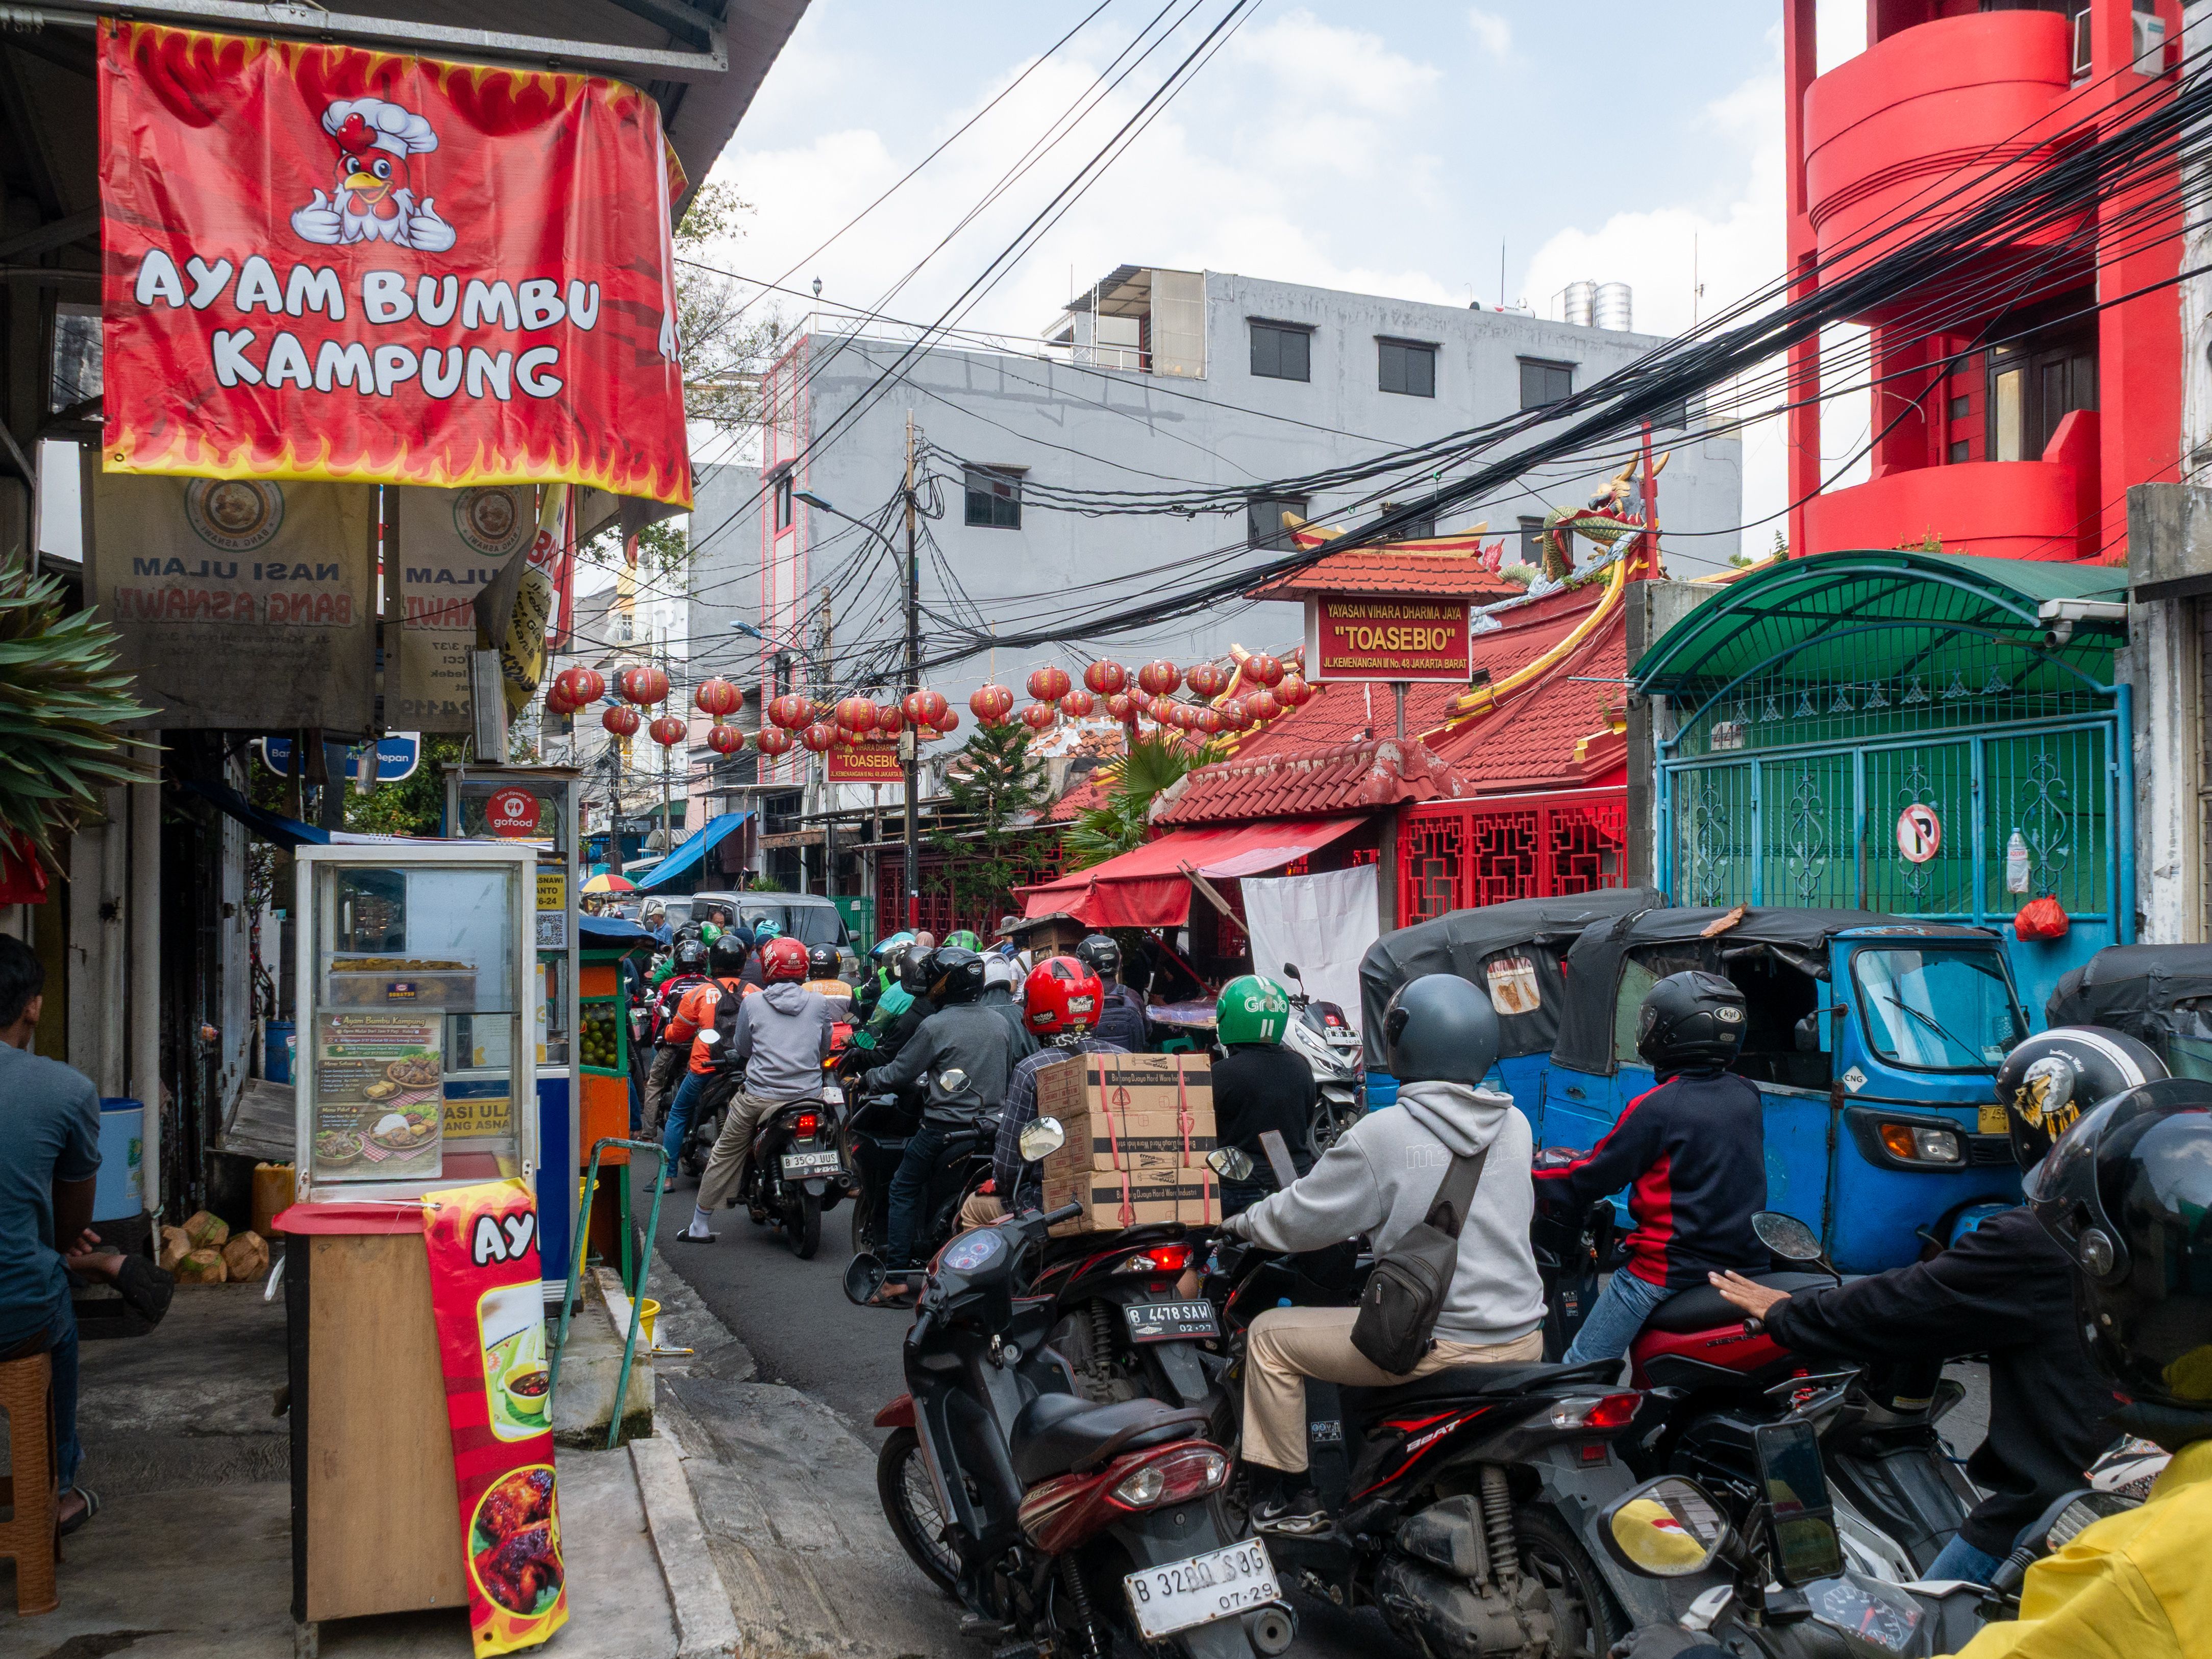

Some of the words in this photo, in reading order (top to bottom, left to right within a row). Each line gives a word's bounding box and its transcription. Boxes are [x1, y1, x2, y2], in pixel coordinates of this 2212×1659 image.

[135, 248, 345, 321] AYAM
[363, 269, 600, 333] BUMBU
[212, 328, 563, 400] KAMPUNG
[1328, 603, 1365, 618] YAYASAN
[1368, 605, 1401, 619] VIHARA
[1403, 605, 1440, 620] DHARMA
[1443, 606, 1461, 620] JAYA
[1335, 626, 1455, 651] "TOASEBIO"
[1390, 658, 1400, 668] No.
[1402, 658, 1410, 668] 48
[1411, 658, 1443, 668] JAKARTA
[1444, 659, 1467, 669] BARAT
[494, 818, 533, 828] gofood
[1244, 995, 1287, 1013] Grab
[343, 1017, 364, 1027] Ayam
[365, 1017, 390, 1025] Bumbu
[392, 1017, 426, 1027] Kampung
[1147, 1074, 1158, 1082] Hard
[1159, 1074, 1171, 1082] Ware
[1845, 1074, 1862, 1083] CNG
[444, 1106, 473, 1120] ASI
[444, 1121, 471, 1131] ANG
[785, 1158, 790, 1167] B
[1152, 1188, 1164, 1197] Hard
[1129, 1309, 1140, 1323] B
[1149, 1306, 1181, 1322] 4478
[1182, 1305, 1208, 1319] SAW
[1134, 1579, 1150, 1602] B
